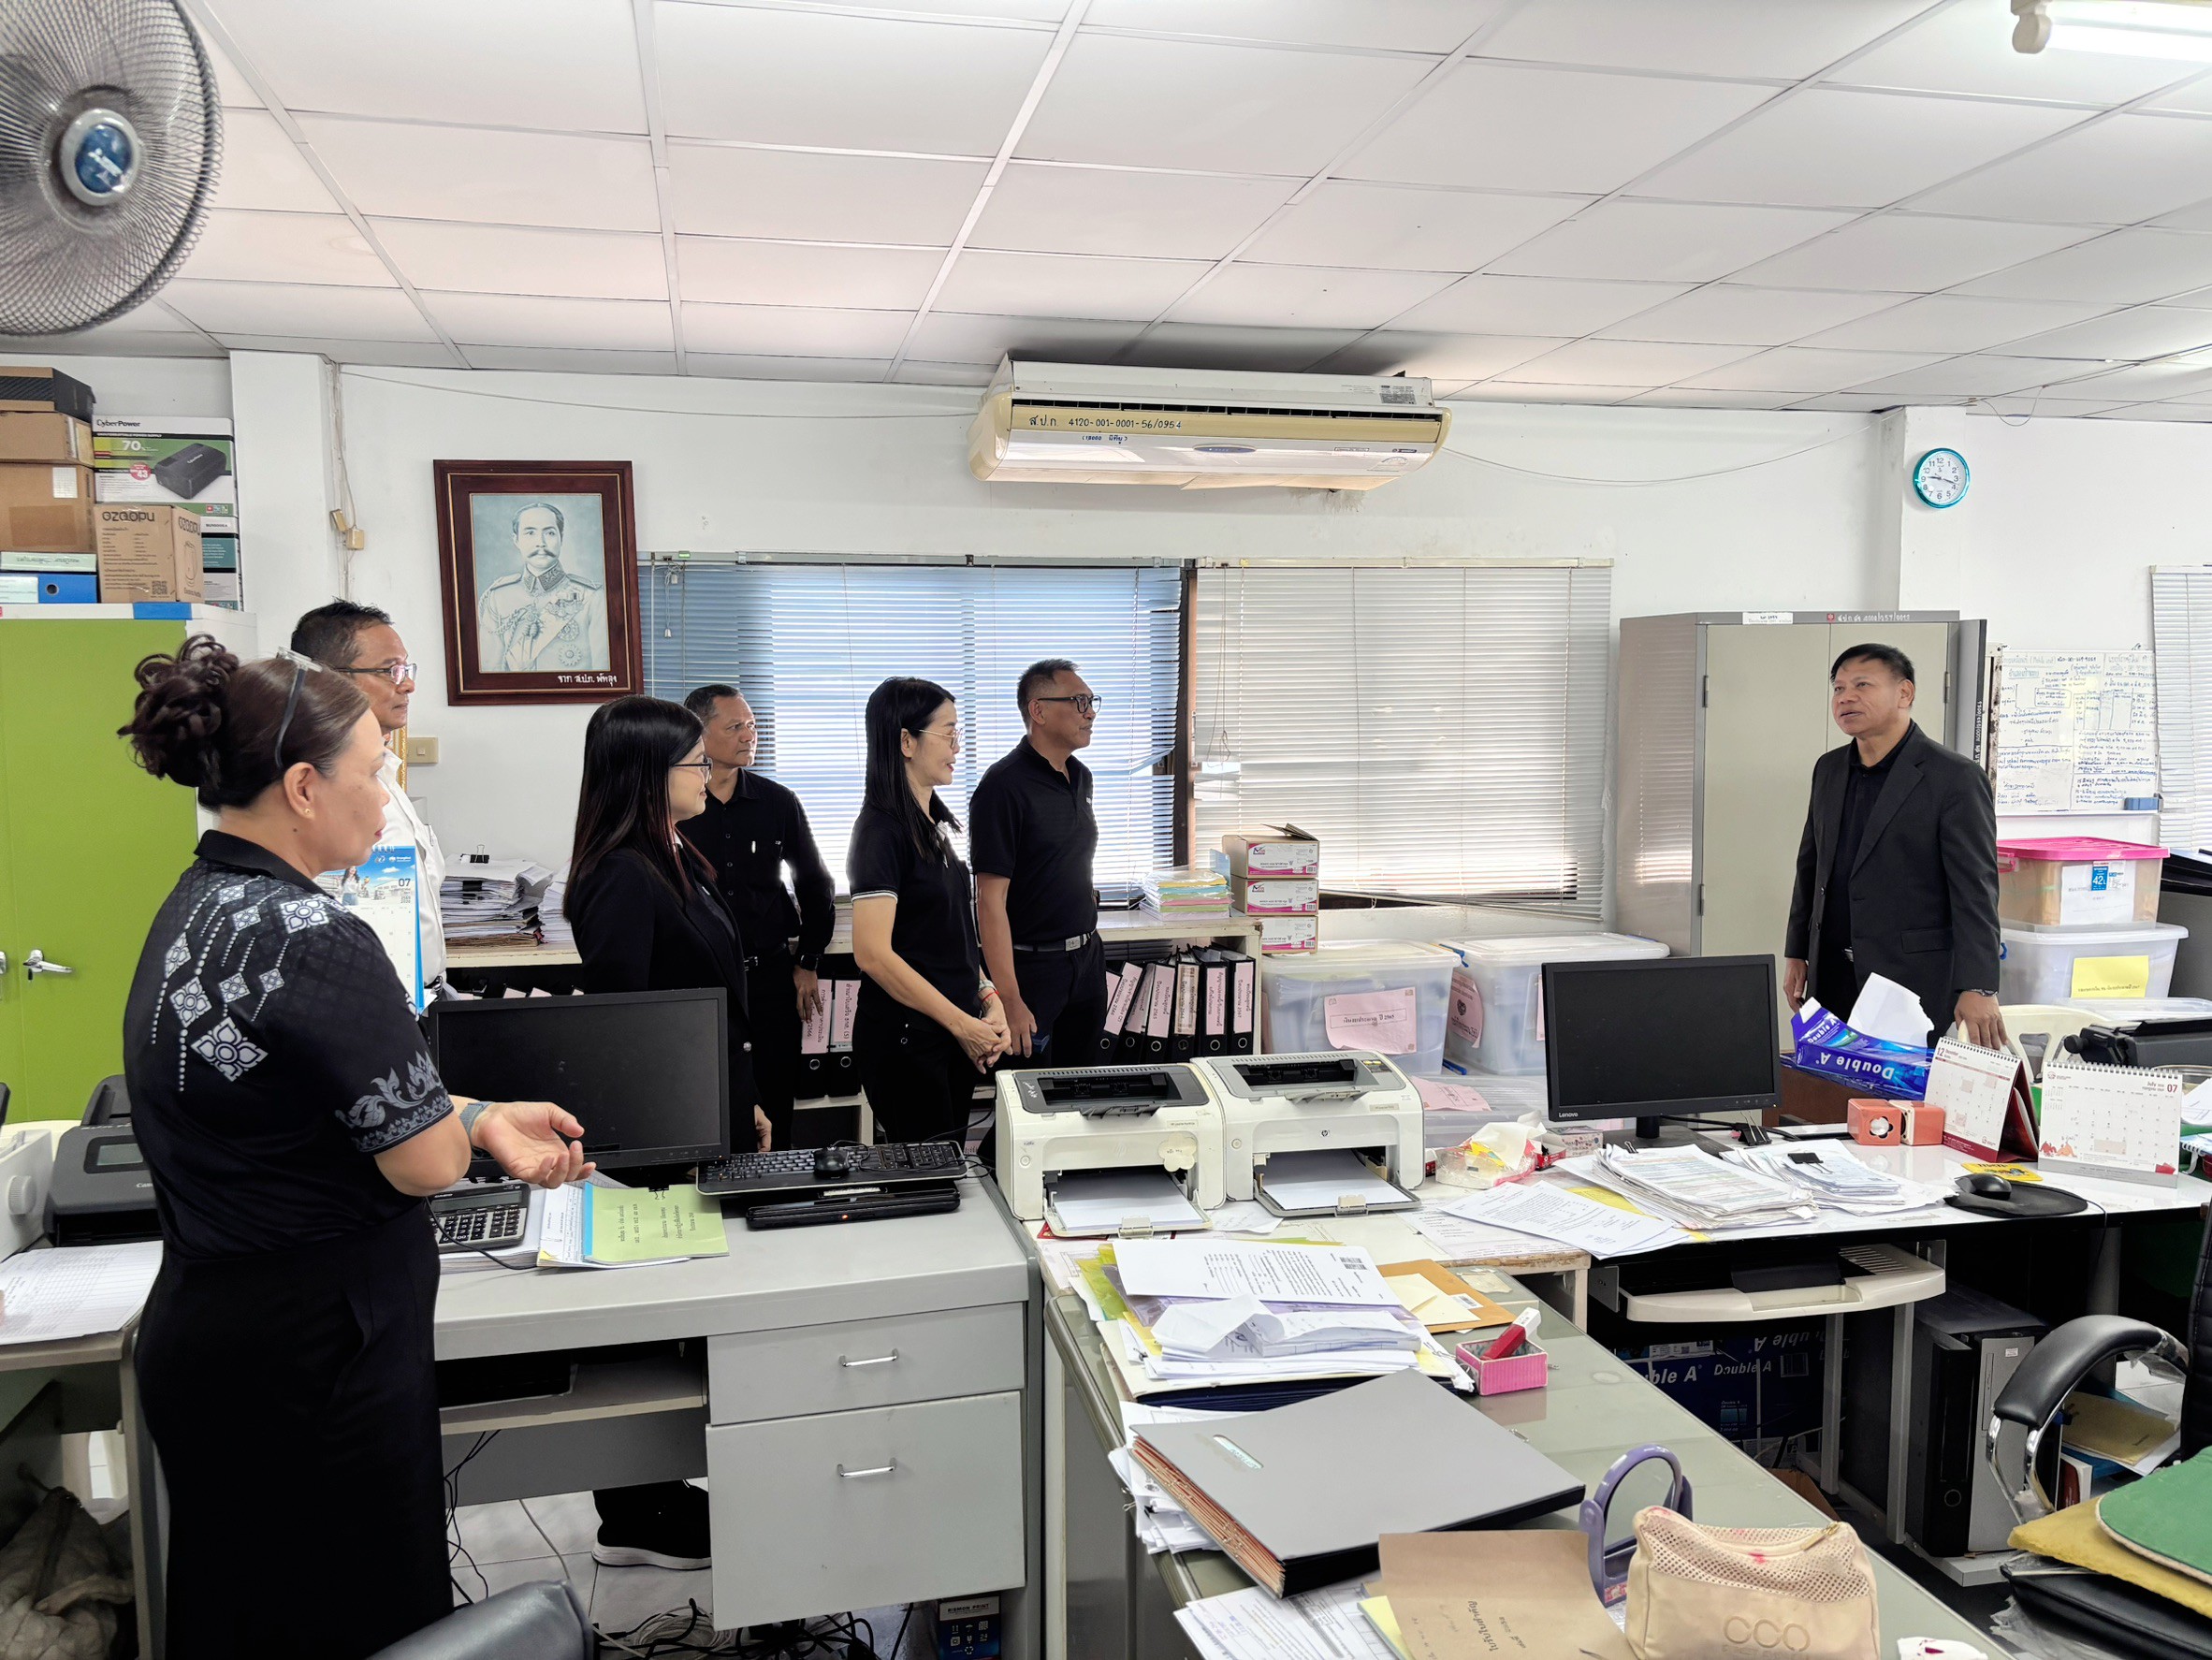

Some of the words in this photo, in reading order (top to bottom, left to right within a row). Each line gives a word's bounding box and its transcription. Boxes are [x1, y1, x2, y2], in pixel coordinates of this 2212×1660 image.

[398, 878, 411, 887] 07
[1808, 1024, 1831, 1043] Double
[1819, 1052, 1832, 1065] A
[1937, 1048, 1944, 1057] 12
[1836, 1056, 1895, 1081] Double
[2167, 1084, 2178, 1093] 07
[1762, 1361, 1772, 1373] A
[1683, 1365, 1698, 1382] A
